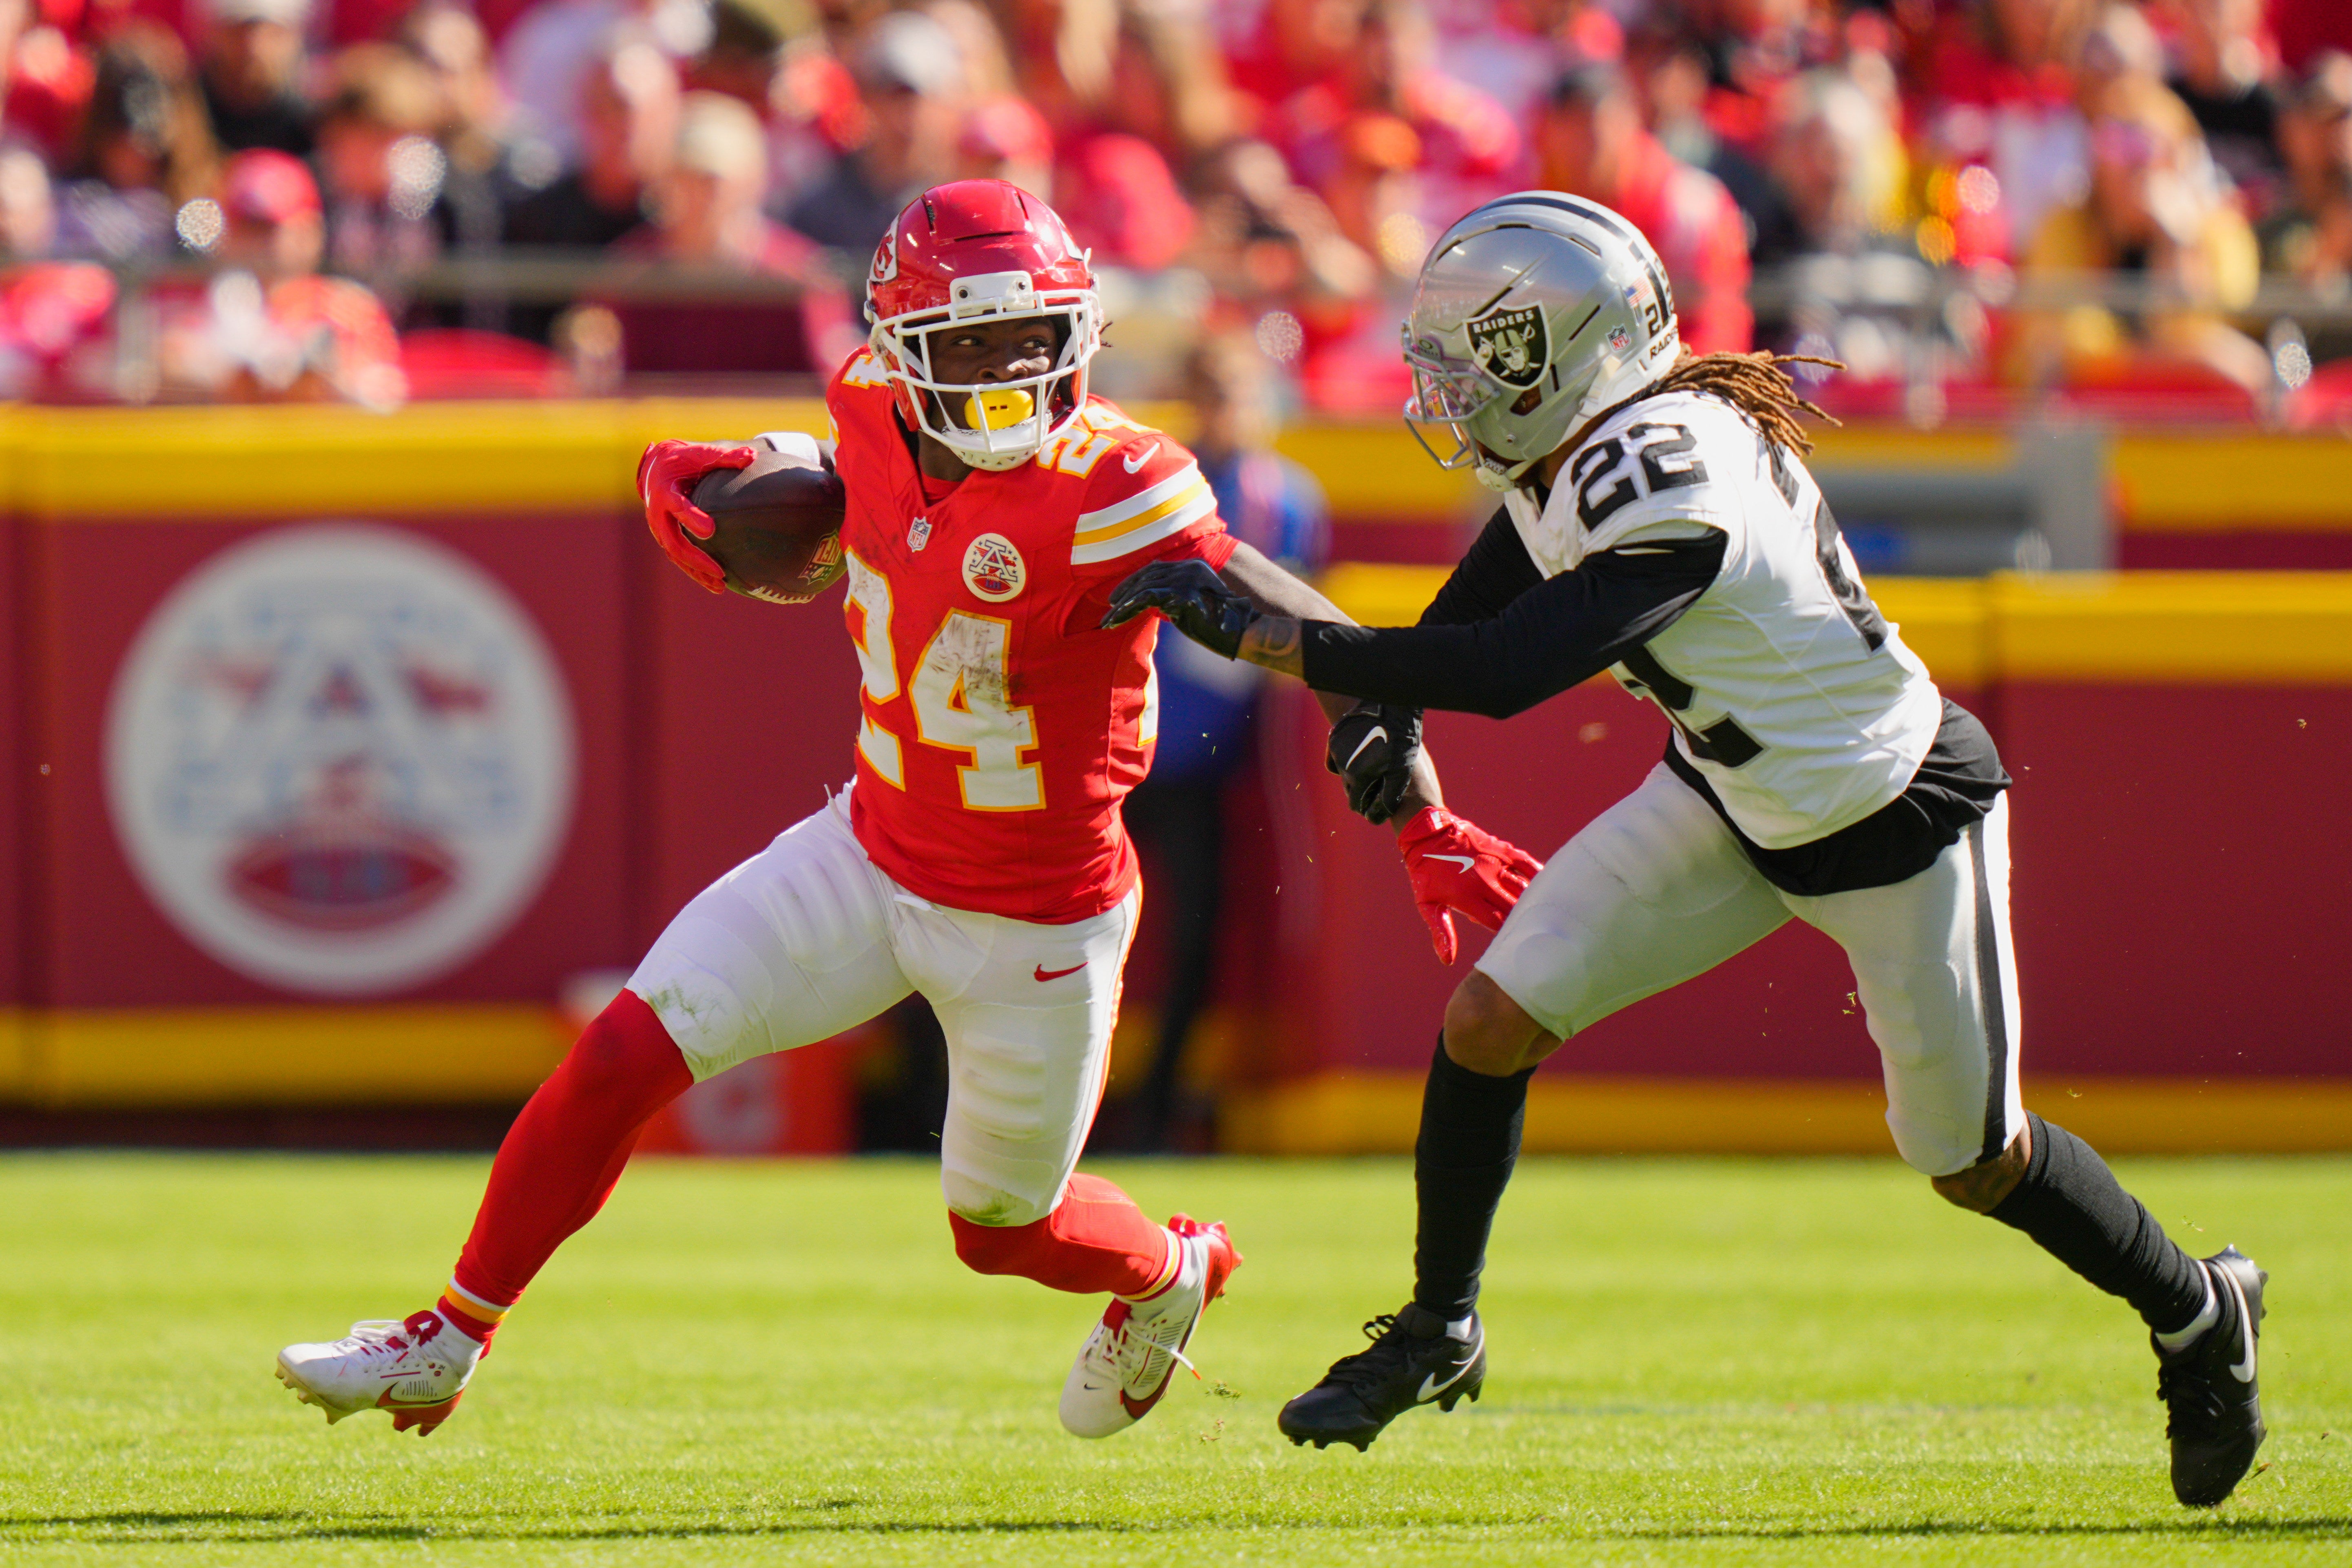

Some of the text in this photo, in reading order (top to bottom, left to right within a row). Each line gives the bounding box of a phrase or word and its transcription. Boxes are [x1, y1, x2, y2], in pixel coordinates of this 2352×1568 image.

[1473, 310, 1535, 334] RAIDERS
[1612, 335, 1629, 349] NFL
[1035, 403, 1163, 480] 24
[1570, 422, 1710, 533] 22
[816, 537, 840, 564] NFL
[909, 530, 924, 546] NFL
[969, 539, 1018, 582] A
[985, 578, 1002, 590] LH
[843, 545, 1047, 812] 24
